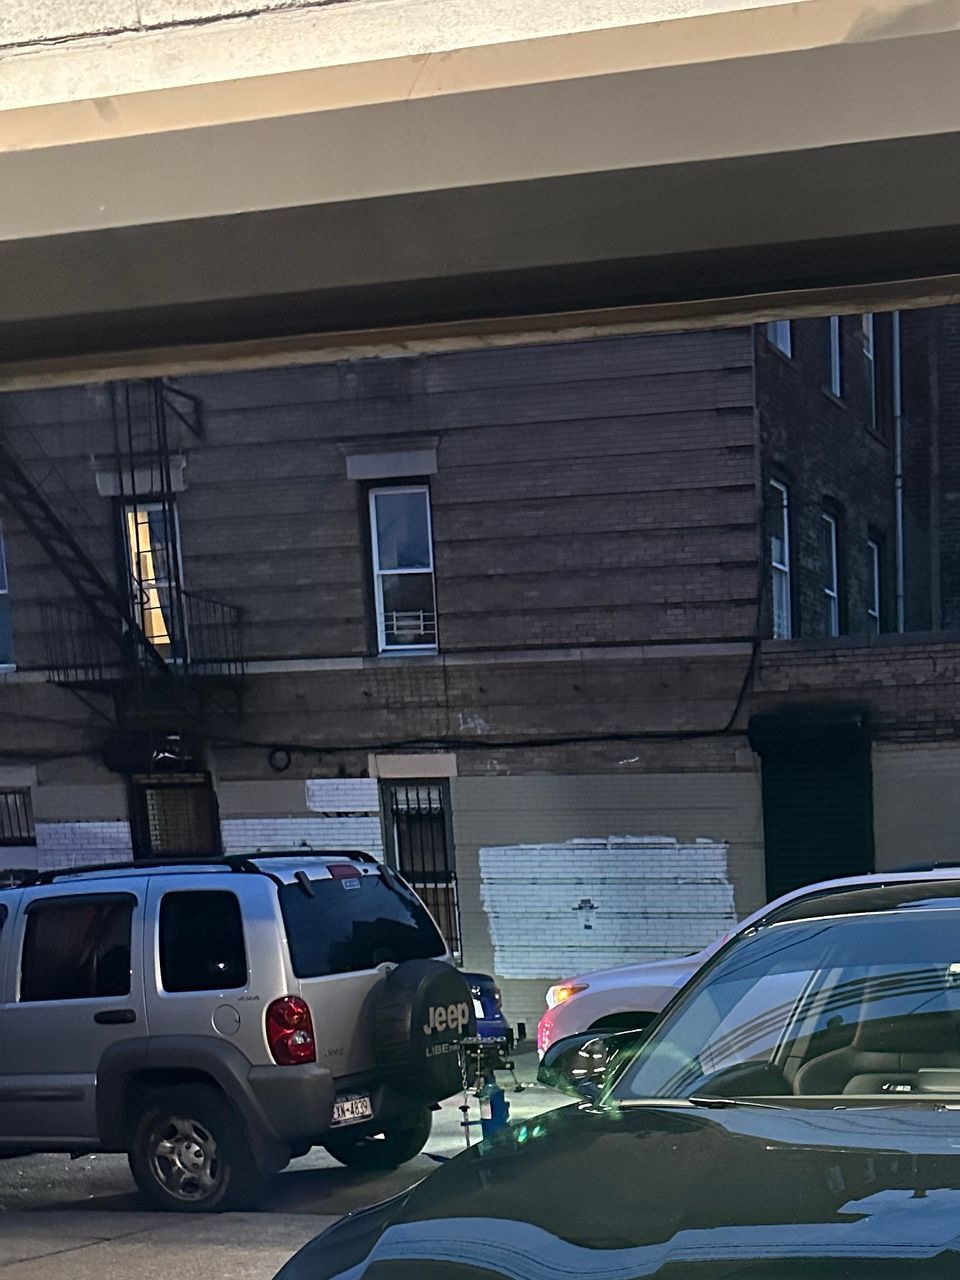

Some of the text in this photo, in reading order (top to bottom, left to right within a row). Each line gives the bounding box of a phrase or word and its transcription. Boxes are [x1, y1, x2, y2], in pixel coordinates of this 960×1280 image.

[423, 1002, 470, 1035] Jeep
[426, 1043, 460, 1057] LIBE
[333, 1099, 369, 1118] XN-4839
